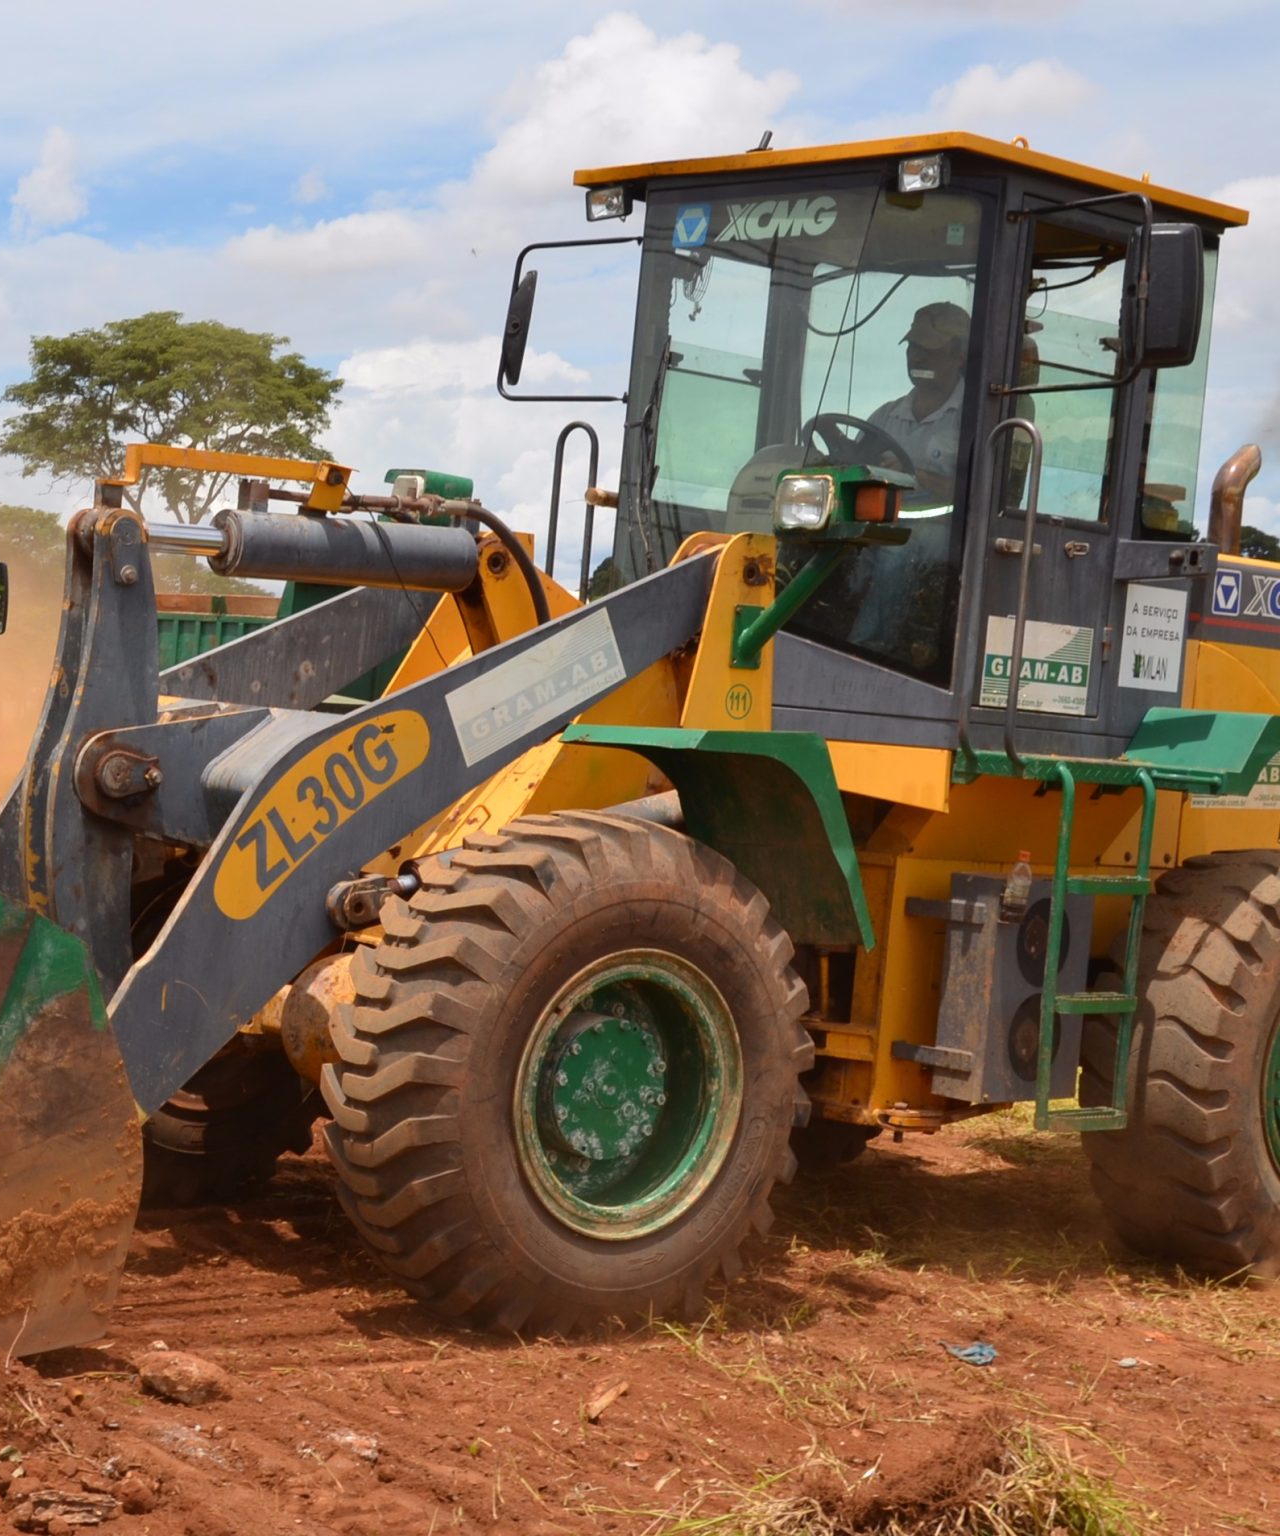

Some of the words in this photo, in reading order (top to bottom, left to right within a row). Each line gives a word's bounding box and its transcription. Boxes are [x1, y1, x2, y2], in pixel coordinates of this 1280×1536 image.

[714, 196, 838, 243] XCMG
[1132, 602, 1140, 614] A
[1142, 605, 1179, 623] SERVIÇO
[1126, 626, 1138, 636] DA
[1141, 627, 1180, 642] EMPRESA
[1140, 655, 1168, 681] MILAN
[471, 650, 609, 739] GRAM-AB
[236, 723, 399, 892] ZL30G
